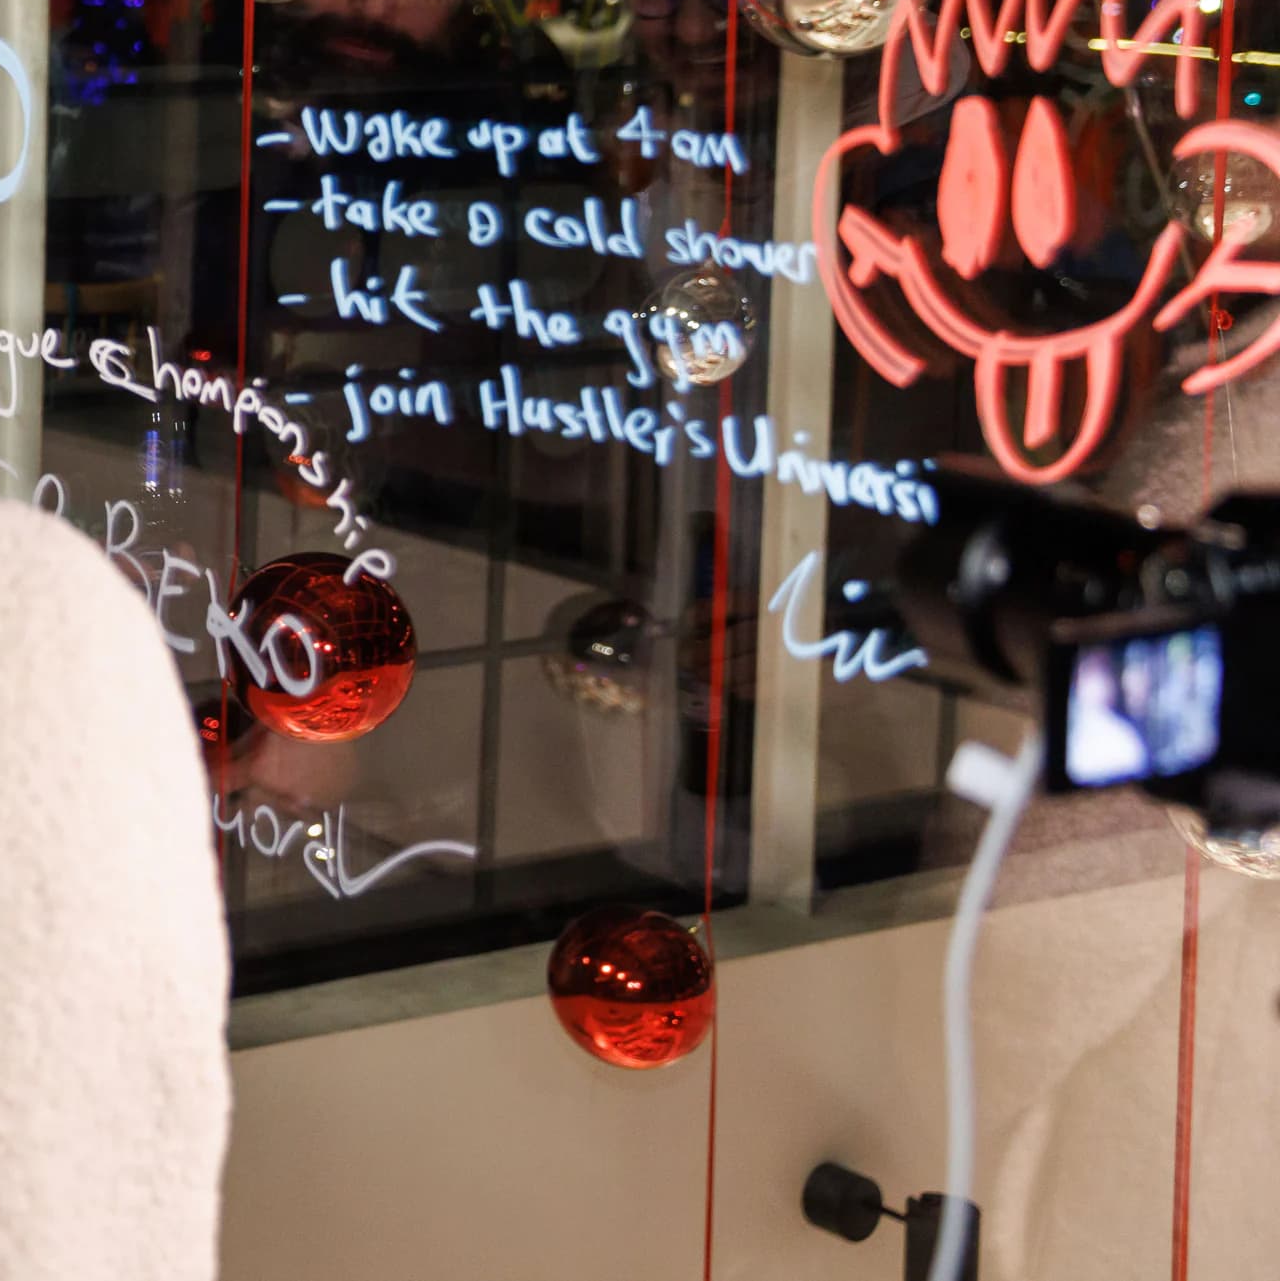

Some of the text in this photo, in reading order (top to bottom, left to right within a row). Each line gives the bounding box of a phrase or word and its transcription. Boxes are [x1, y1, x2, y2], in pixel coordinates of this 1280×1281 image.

[300, 104, 458, 163] Wake
[467, 119, 523, 176] up
[539, 111, 601, 163] at
[615, 105, 667, 159] 4
[670, 130, 747, 175] am
[310, 174, 441, 238] take
[523, 197, 643, 260] cold
[330, 258, 444, 332] hit
[469, 279, 579, 347] the
[603, 307, 746, 395] gym
[343, 363, 449, 443] join
